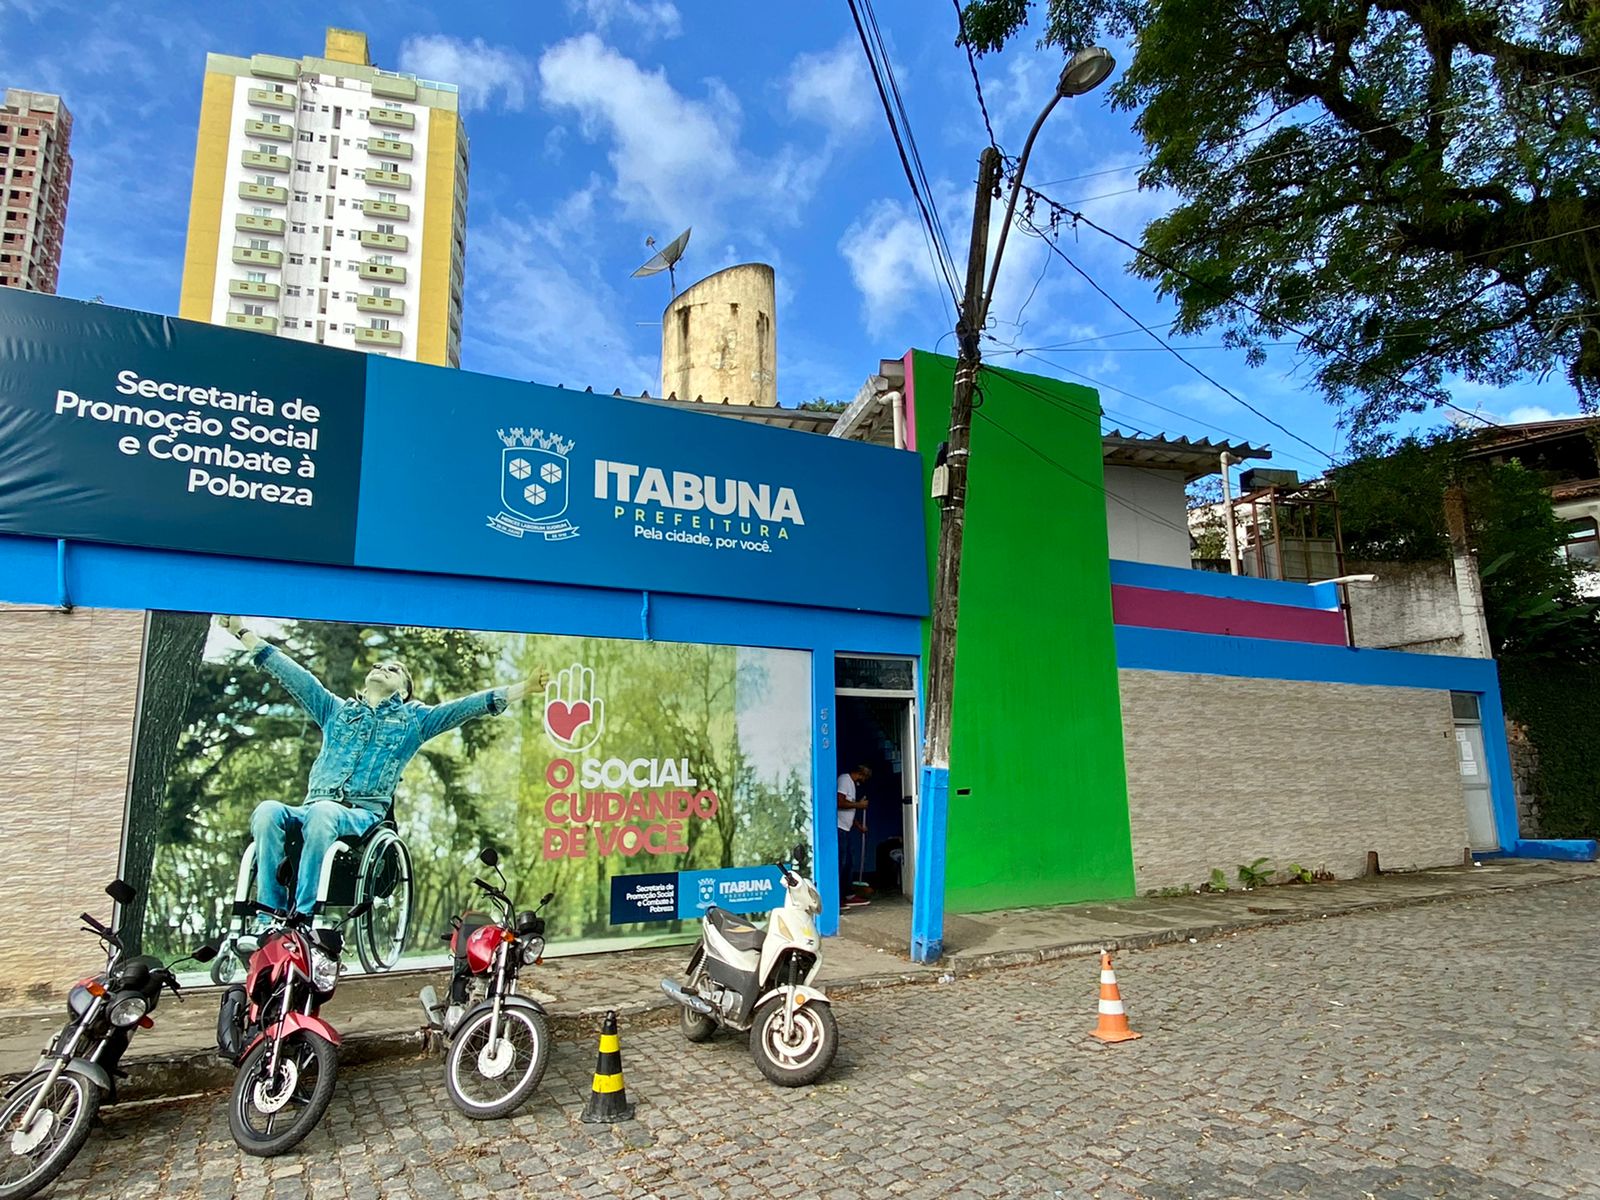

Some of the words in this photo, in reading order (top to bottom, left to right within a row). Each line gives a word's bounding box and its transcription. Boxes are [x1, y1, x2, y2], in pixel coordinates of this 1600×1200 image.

[115, 370, 274, 417] Secretaria
[281, 398, 320, 423] de
[55, 389, 223, 438] Promoção
[229, 417, 318, 451] Social
[118, 435, 140, 455] e
[148, 434, 291, 475] Combate
[297, 453, 315, 478] à
[187, 468, 313, 506] Pobreza
[594, 459, 805, 526] ITABUNA
[614, 506, 789, 540] PREFEITURA
[634, 525, 663, 541] Pela
[665, 529, 713, 547] cidade,
[715, 535, 738, 550] por
[739, 537, 772, 553] você.
[546, 758, 575, 789] O
[581, 758, 697, 789] SOCIAL
[544, 789, 719, 824] CUIDANDO
[543, 826, 587, 861] DE
[592, 820, 689, 857] VOCÊ
[719, 879, 772, 894] ITABUNA
